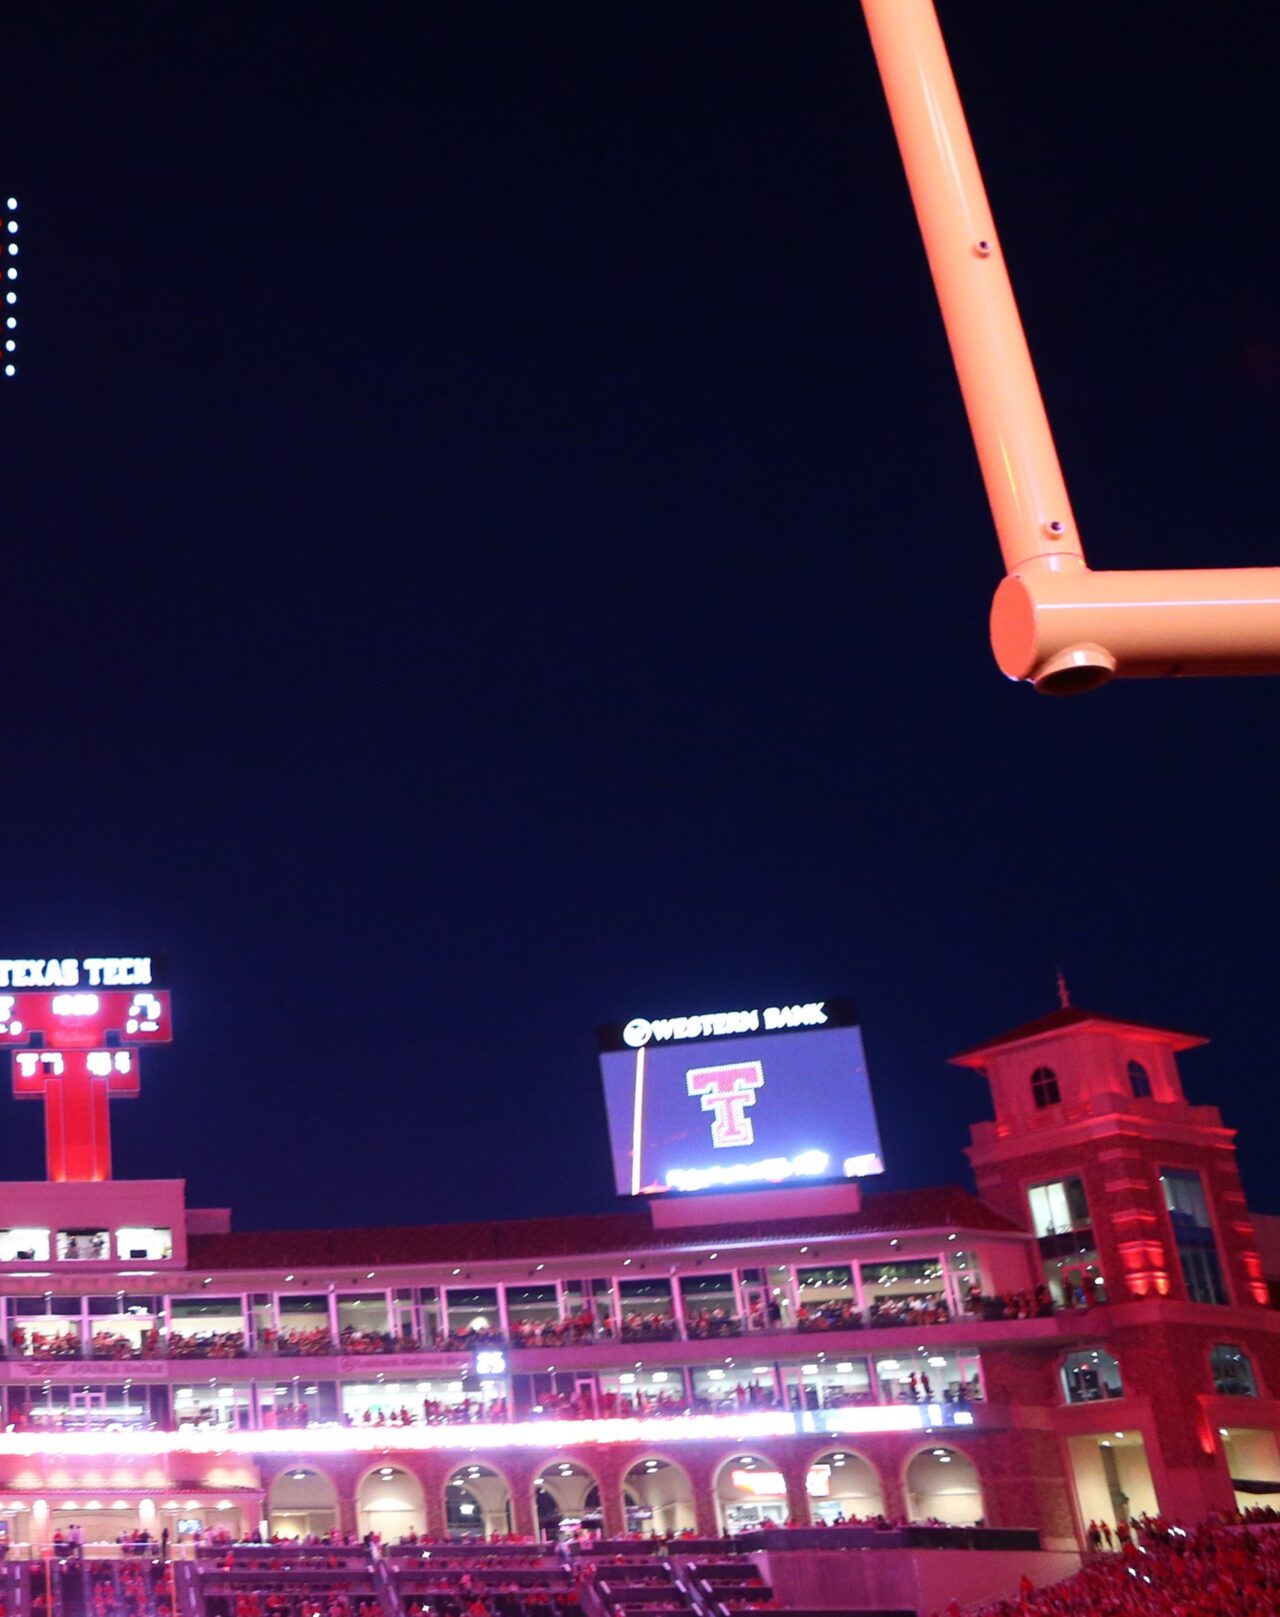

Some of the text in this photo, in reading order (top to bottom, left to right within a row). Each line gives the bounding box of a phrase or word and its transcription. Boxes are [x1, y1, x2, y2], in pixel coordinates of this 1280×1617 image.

[83, 957, 152, 985] TECH
[651, 1002, 828, 1041] WESTERN BANK
